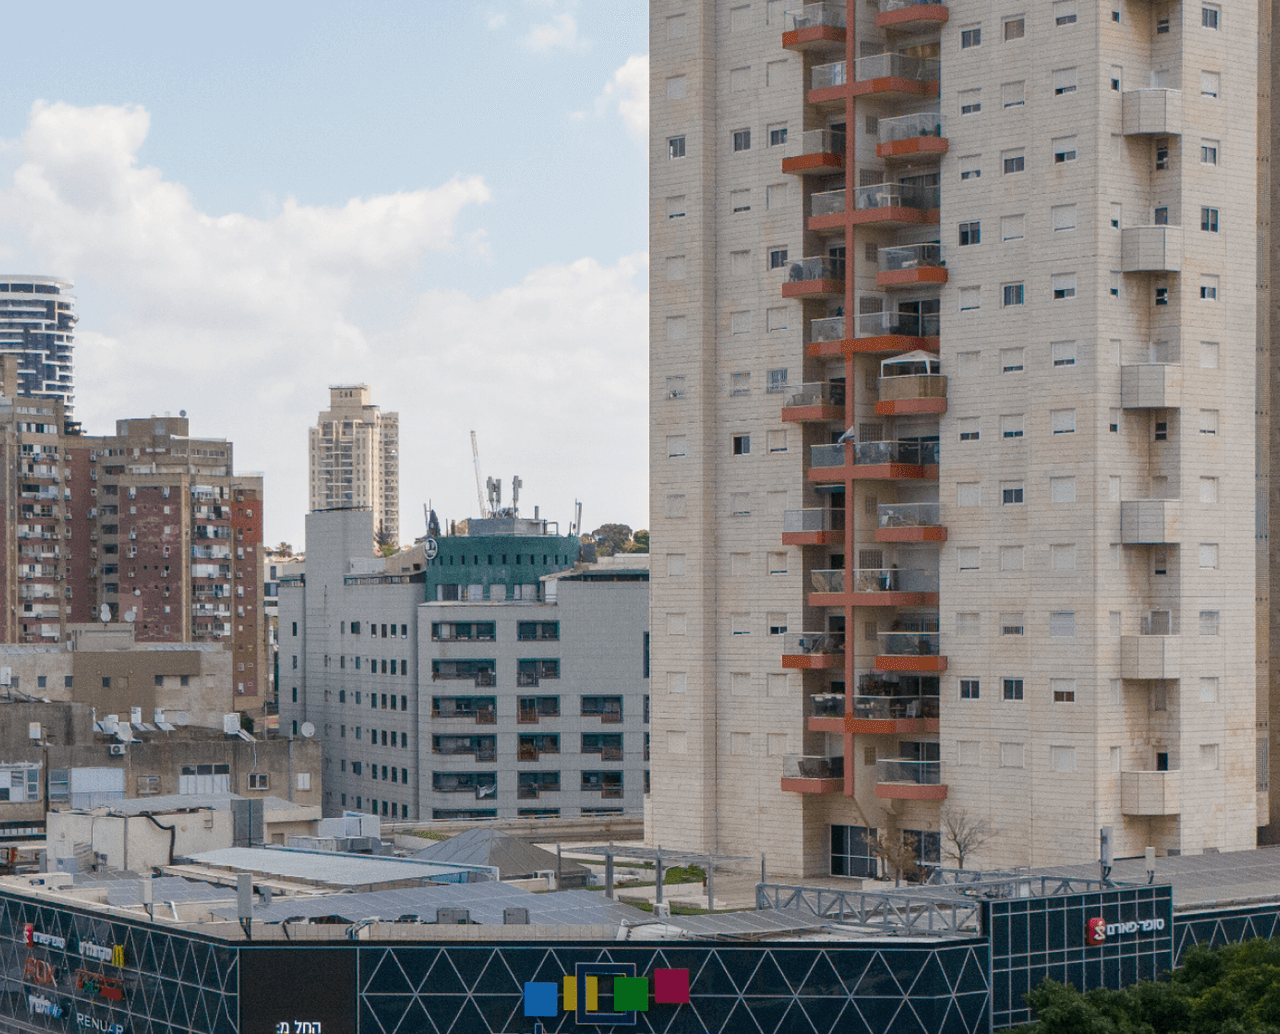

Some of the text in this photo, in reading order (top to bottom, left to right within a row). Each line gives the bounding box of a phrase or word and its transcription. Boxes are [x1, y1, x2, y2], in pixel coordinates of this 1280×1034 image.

[1106, 918, 1165, 936] סופר-פארם
[24, 957, 58, 987] FOX
[294, 1020, 322, 1034] החל
